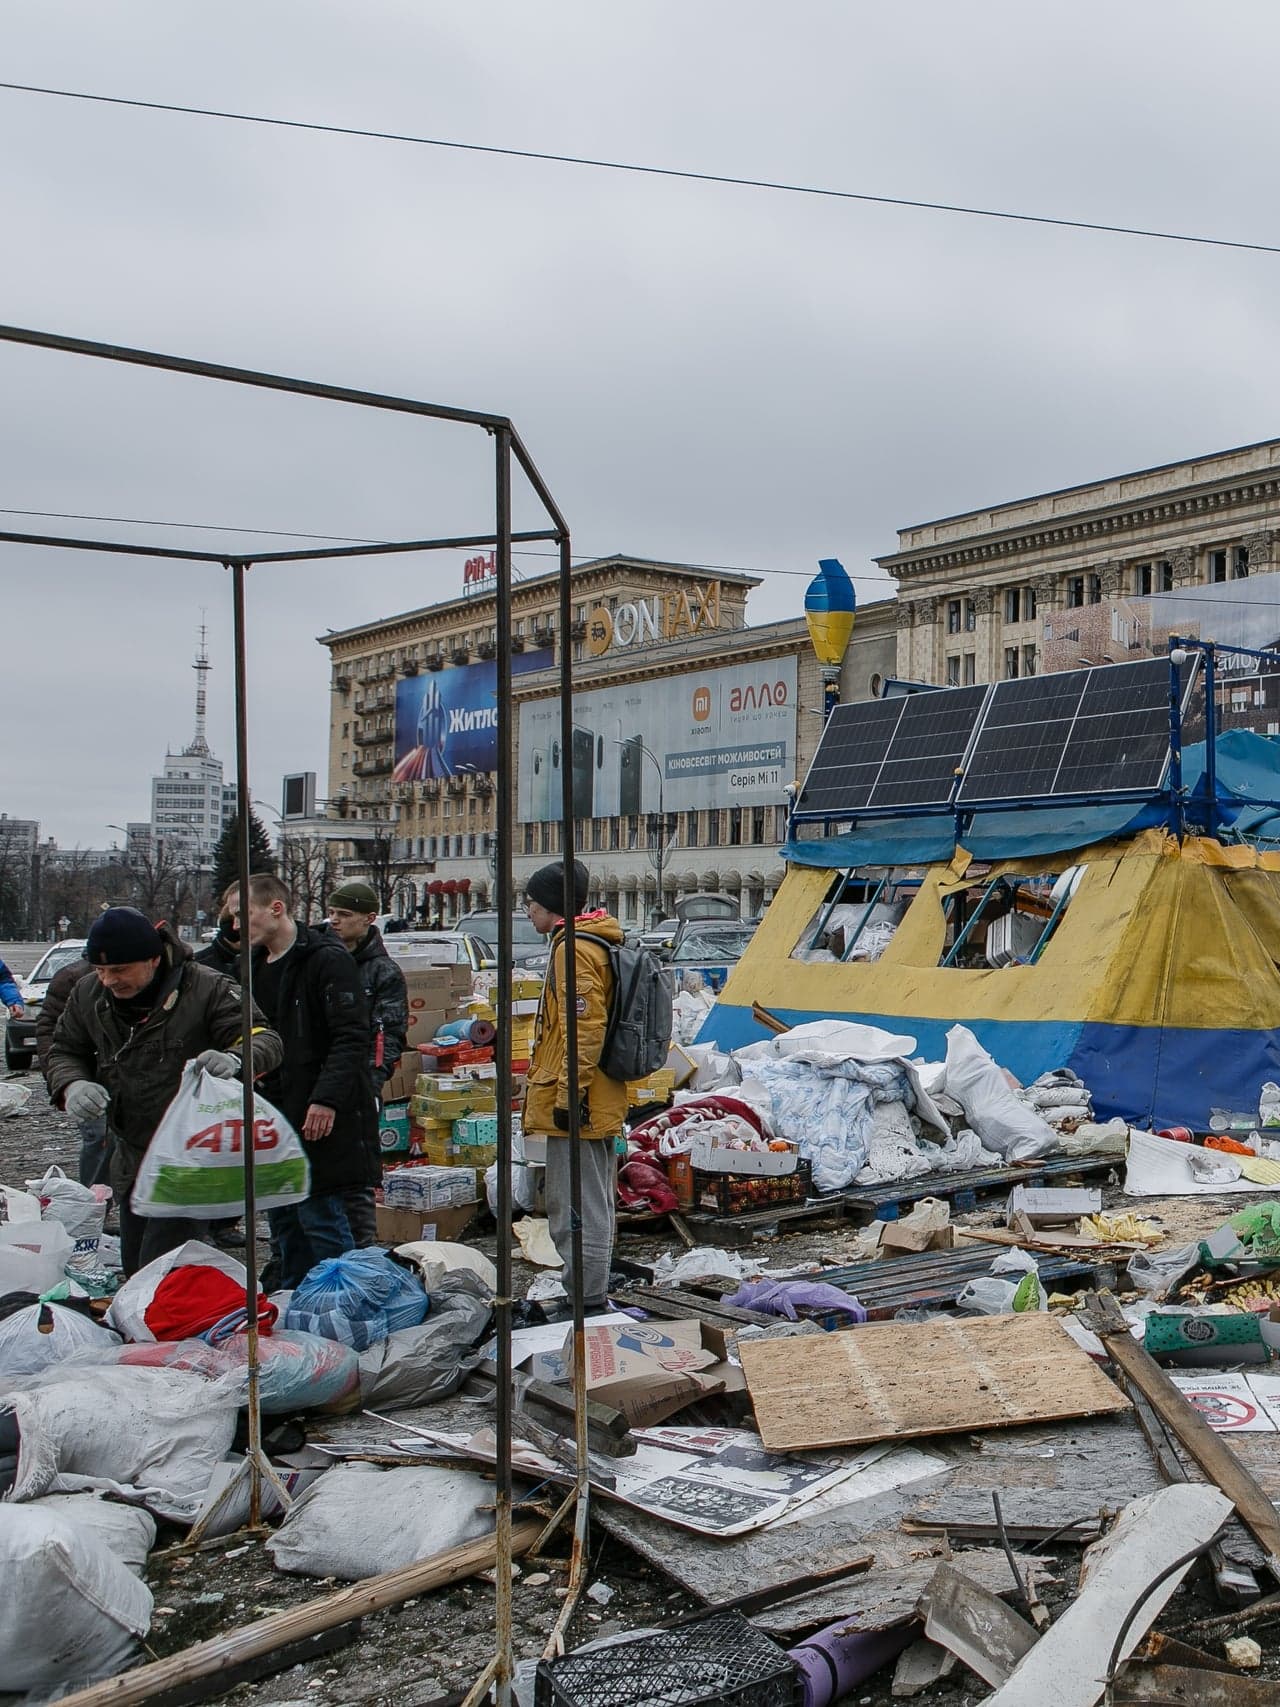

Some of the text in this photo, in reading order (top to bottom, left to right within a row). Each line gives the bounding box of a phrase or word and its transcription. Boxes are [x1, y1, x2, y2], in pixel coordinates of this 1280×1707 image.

[668, 745, 782, 770] КІНОВСЕСВІТ МОЖЛИВОСТЕЙ
[730, 774, 756, 788] Серія
[770, 770, 779, 783] 11
